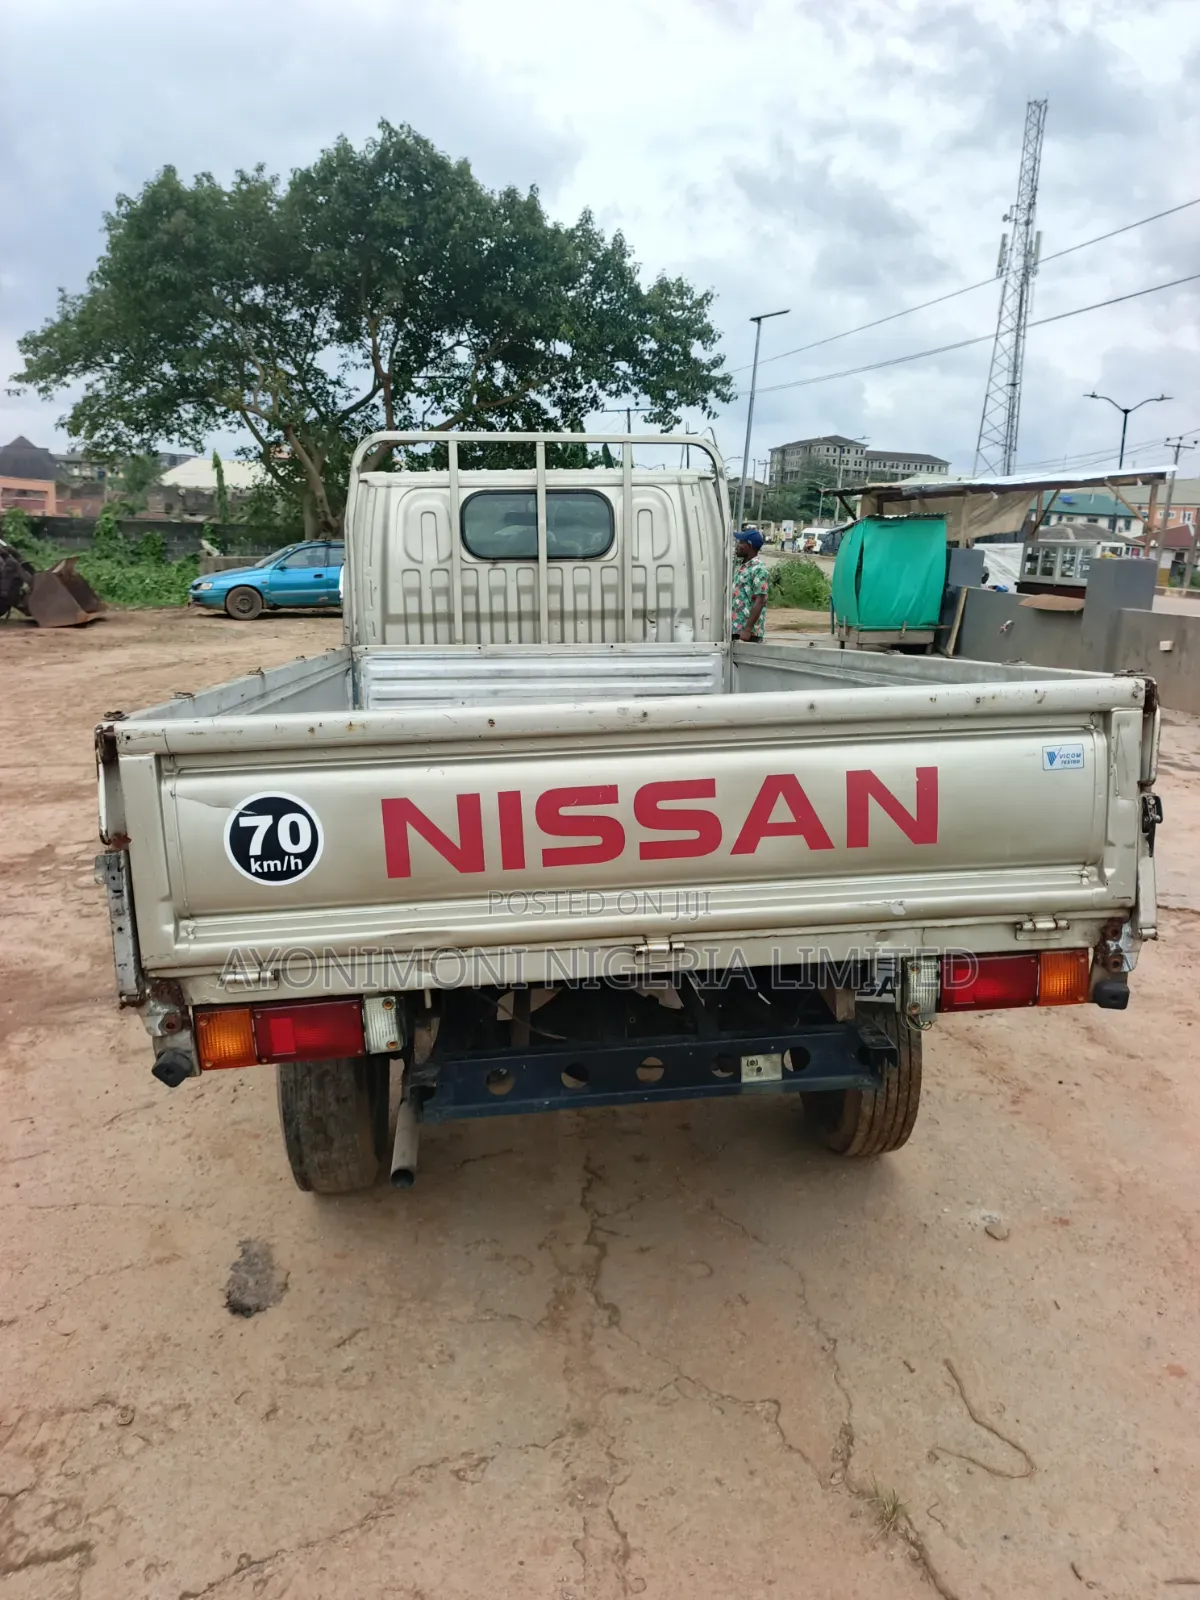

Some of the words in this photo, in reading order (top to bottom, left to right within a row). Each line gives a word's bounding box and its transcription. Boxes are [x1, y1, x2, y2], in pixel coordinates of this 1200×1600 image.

[238, 812, 312, 857] 70
[380, 765, 939, 879] NISSAN
[250, 855, 303, 873] km/h
